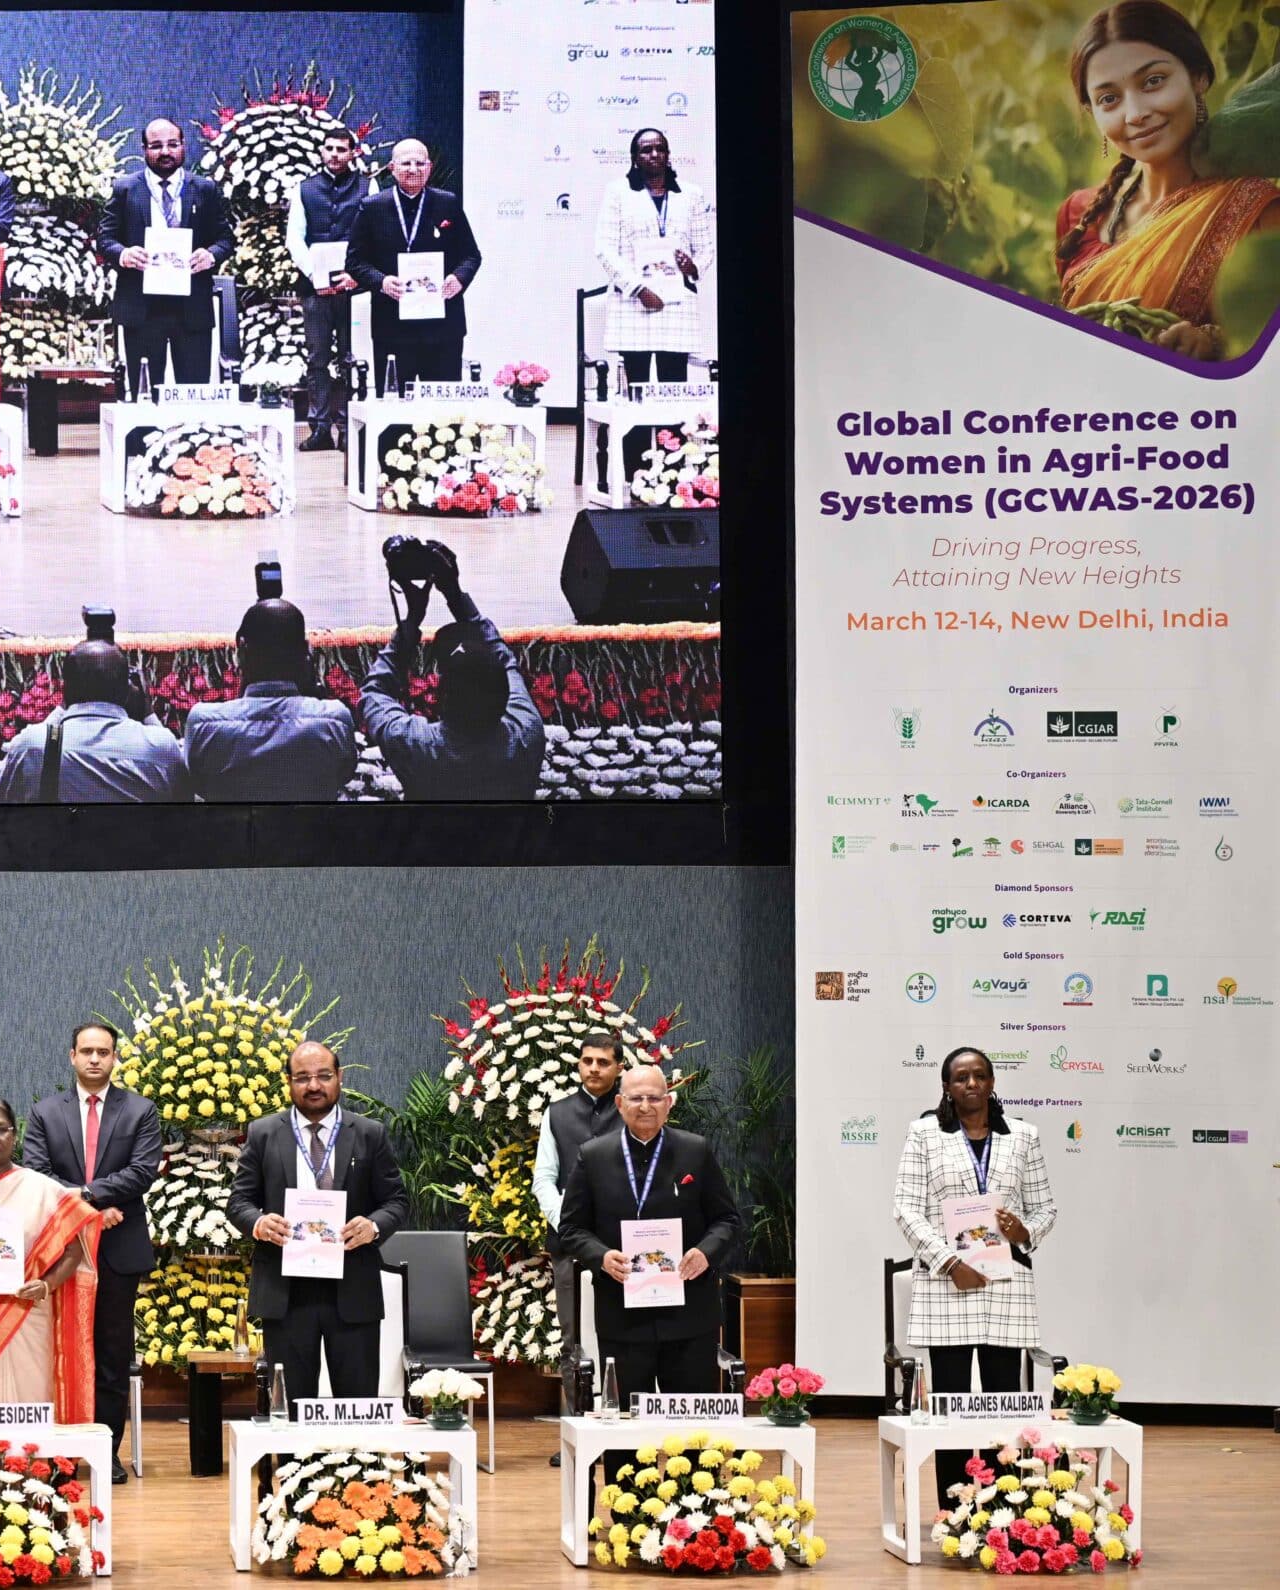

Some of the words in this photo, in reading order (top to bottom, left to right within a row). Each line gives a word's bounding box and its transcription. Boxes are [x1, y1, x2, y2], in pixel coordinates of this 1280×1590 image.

[456, 385, 489, 398] PARODA
[836, 410, 951, 437] Global
[963, 407, 1179, 434] Conference
[1190, 405, 1238, 430] on
[845, 448, 986, 476] Women
[997, 446, 1032, 474] in
[1042, 443, 1230, 478] Agri-Food
[820, 490, 973, 521] Systems
[984, 483, 1256, 519] (GCWAS-2026)
[931, 537, 1021, 561] Driving
[1029, 535, 1143, 559] Progress,
[892, 567, 1010, 591] Attaining
[1018, 566, 1077, 587] New
[1082, 564, 1182, 589] Heights
[846, 612, 927, 632] March
[934, 610, 1003, 634] 12-14,
[1010, 610, 1070, 630] New
[1078, 608, 1154, 632] Delhi,
[1162, 607, 1229, 629] India
[1008, 685, 1058, 695] Organizers
[1078, 724, 1114, 734] CGIAR
[1006, 770, 1066, 779] Co-Organizers
[834, 797, 881, 806] CIMMYT
[988, 800, 1030, 808] ICARDA
[1034, 884, 1074, 893] Sponsors
[932, 908, 967, 917] mahyco
[1020, 914, 1071, 922] CORTEVA
[932, 916, 987, 934] grow
[1024, 952, 1064, 961] Sponsors
[1027, 1023, 1066, 1031] Sponsors
[1061, 1062, 1104, 1071] CRYSTAL
[997, 1098, 1044, 1107] Knowledge
[841, 1132, 878, 1141] MSSRF
[647, 1398, 665, 1415] DR.
[669, 1398, 690, 1415] R.S.
[694, 1398, 739, 1415] PARODA
[951, 1397, 965, 1412] DR.
[968, 1396, 997, 1412] AGNES
[1001, 1396, 1043, 1411] KALIBATA
[304, 1404, 329, 1420] DR.
[335, 1403, 393, 1420] M.L.JAT
